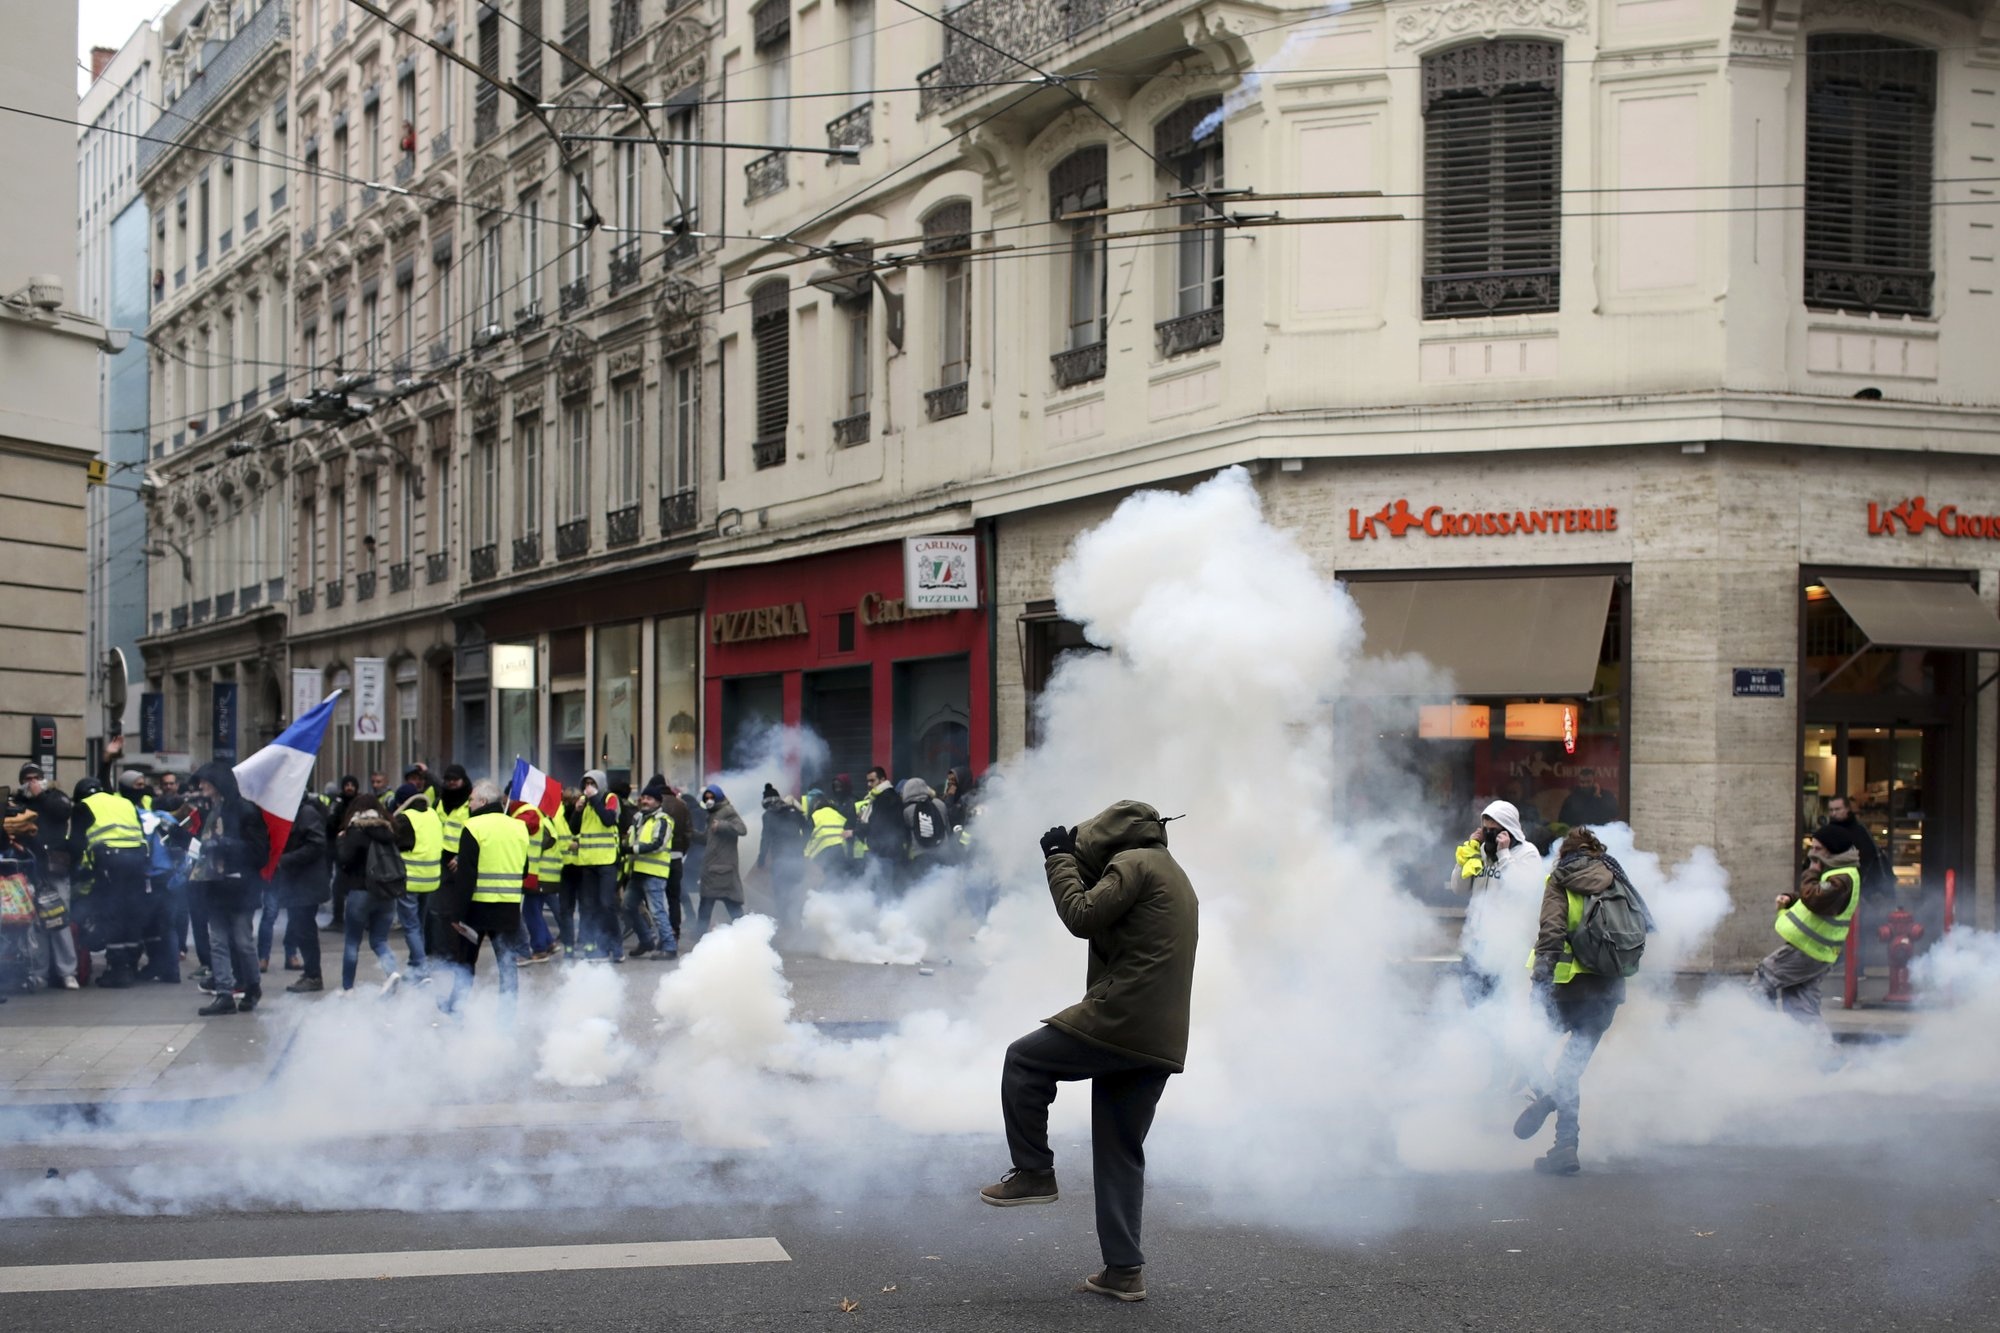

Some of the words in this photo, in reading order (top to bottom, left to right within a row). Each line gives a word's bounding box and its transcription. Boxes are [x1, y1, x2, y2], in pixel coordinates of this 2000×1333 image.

[1349, 508, 1377, 539] LA
[1423, 505, 1618, 537] CROISSANTERIE
[1867, 502, 1896, 536] LA
[915, 541, 968, 553] CARLINO
[918, 594, 969, 603] PIZZERIA
[711, 601, 808, 644] PIZZERIA
[918, 811, 934, 838] NIKE
[1475, 866, 1502, 879] dida
